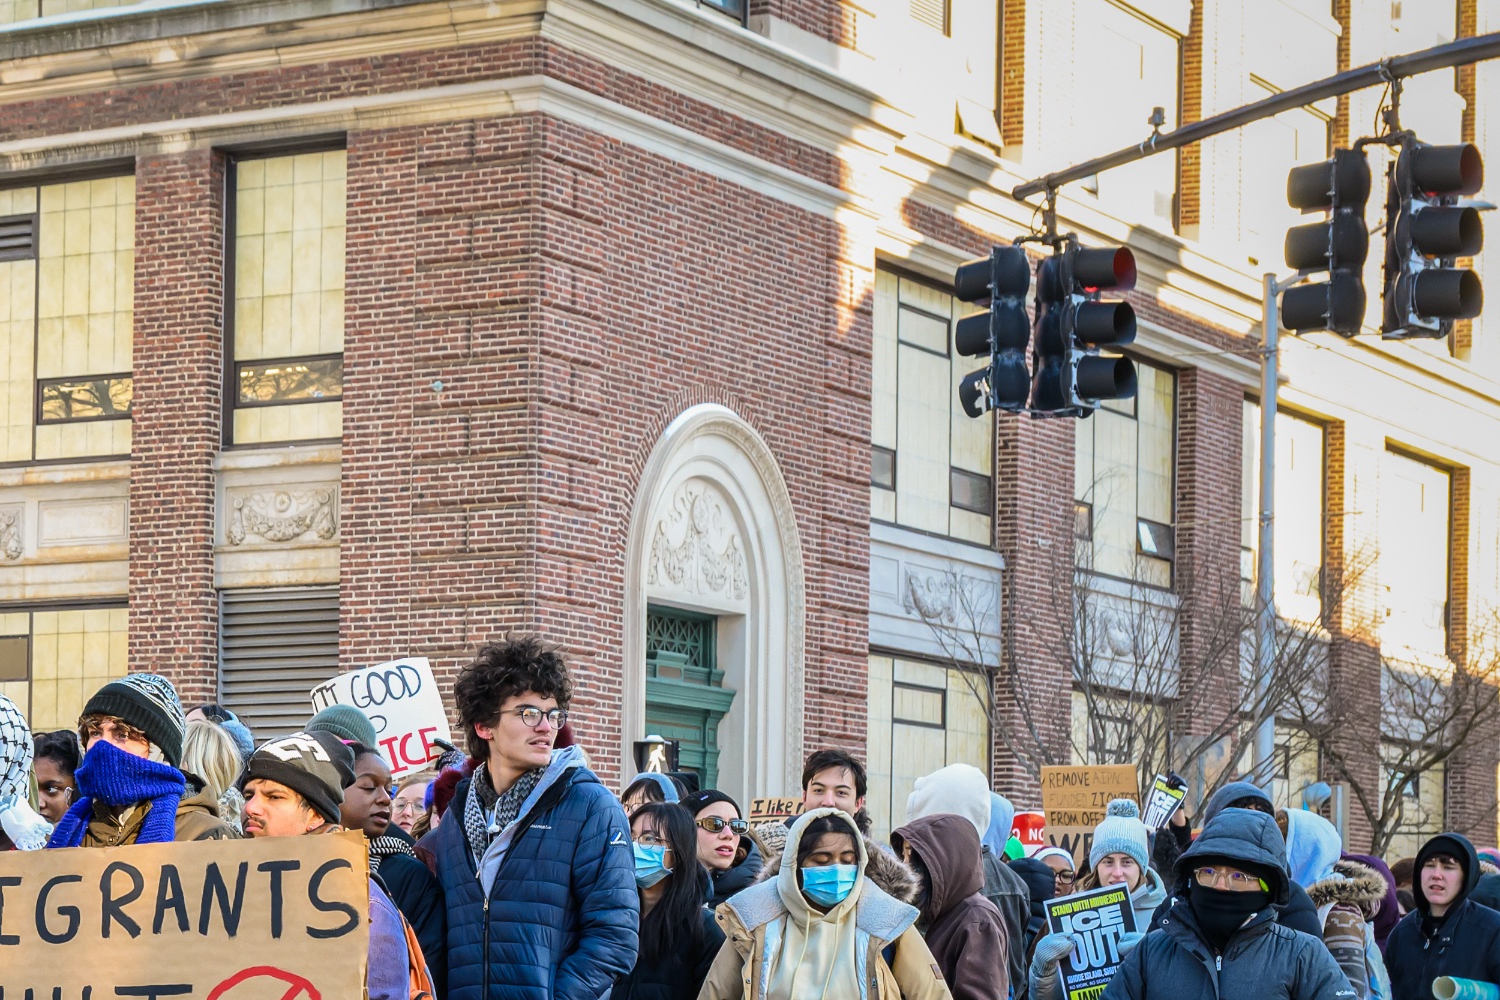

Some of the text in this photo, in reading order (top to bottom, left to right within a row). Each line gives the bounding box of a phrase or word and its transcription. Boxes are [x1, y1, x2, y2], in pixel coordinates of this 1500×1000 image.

[350, 664, 422, 708] GOOD
[379, 726, 442, 775] ICE
[1049, 771, 1090, 788] REMOVE
[751, 800, 765, 813] I
[767, 799, 793, 814] like
[1050, 793, 1088, 808] FUNDED
[1151, 789, 1178, 811] ICE
[1051, 811, 1079, 826] FROM
[1051, 891, 1126, 917] STAND WITH MINNESOTA
[1060, 904, 1124, 934] ICE
